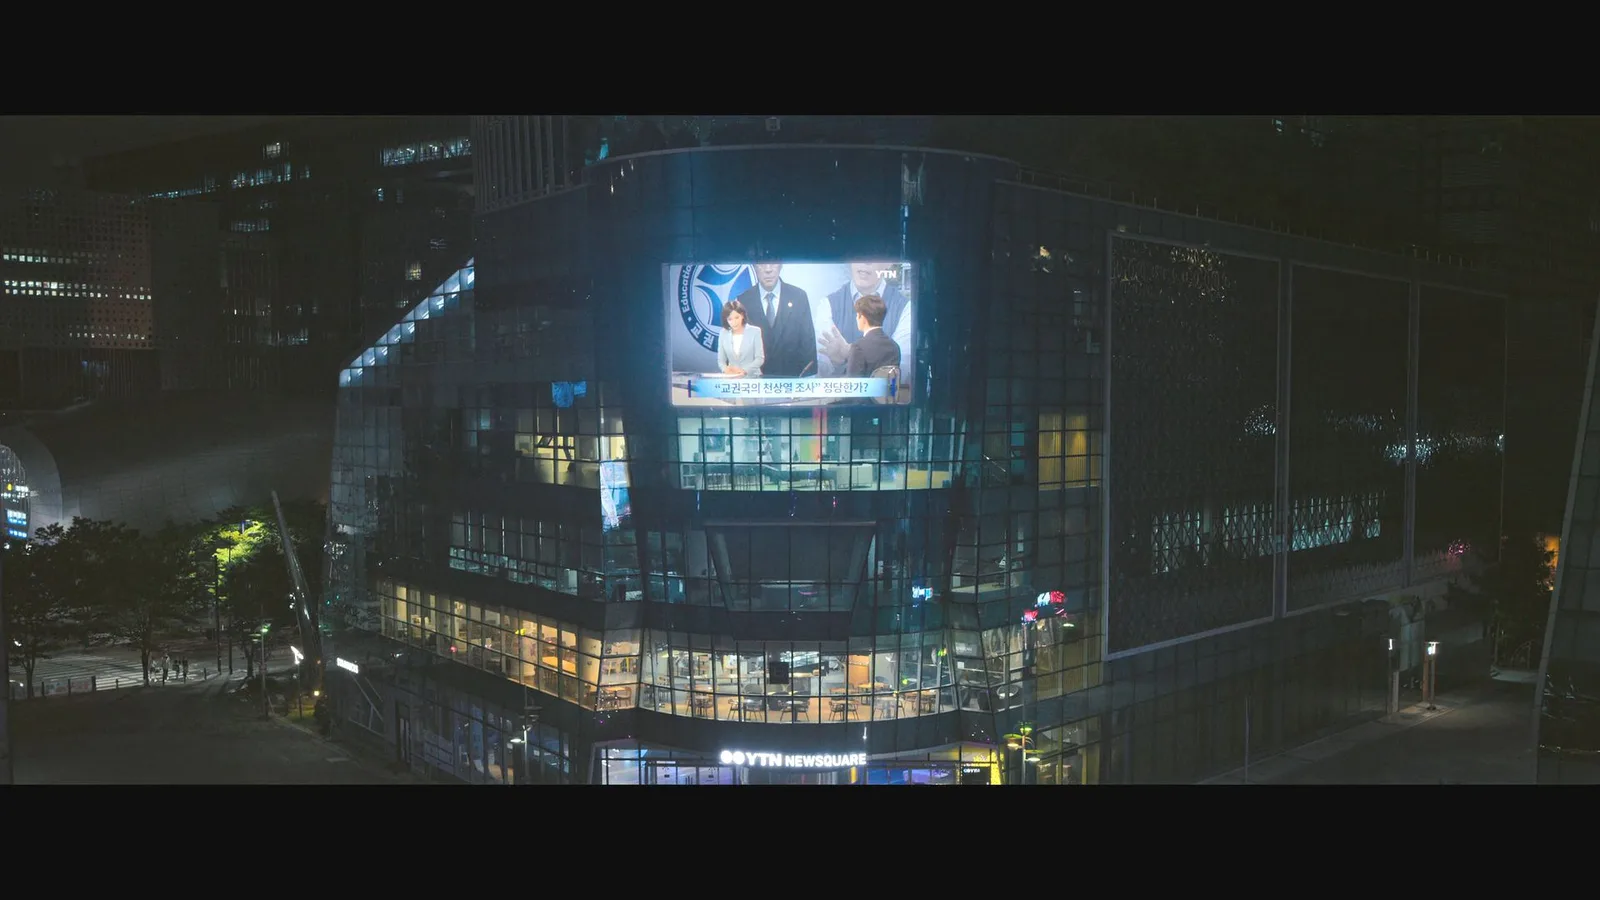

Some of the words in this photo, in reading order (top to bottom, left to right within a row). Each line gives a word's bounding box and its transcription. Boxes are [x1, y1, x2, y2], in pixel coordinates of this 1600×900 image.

[875, 270, 897, 279] YTN
[680, 264, 693, 313] Educatio
[763, 382, 793, 394] 천상열
[823, 382, 869, 394] 정당한가?
[745, 752, 782, 767] YTN
[785, 753, 867, 768] NEWSQUARE
